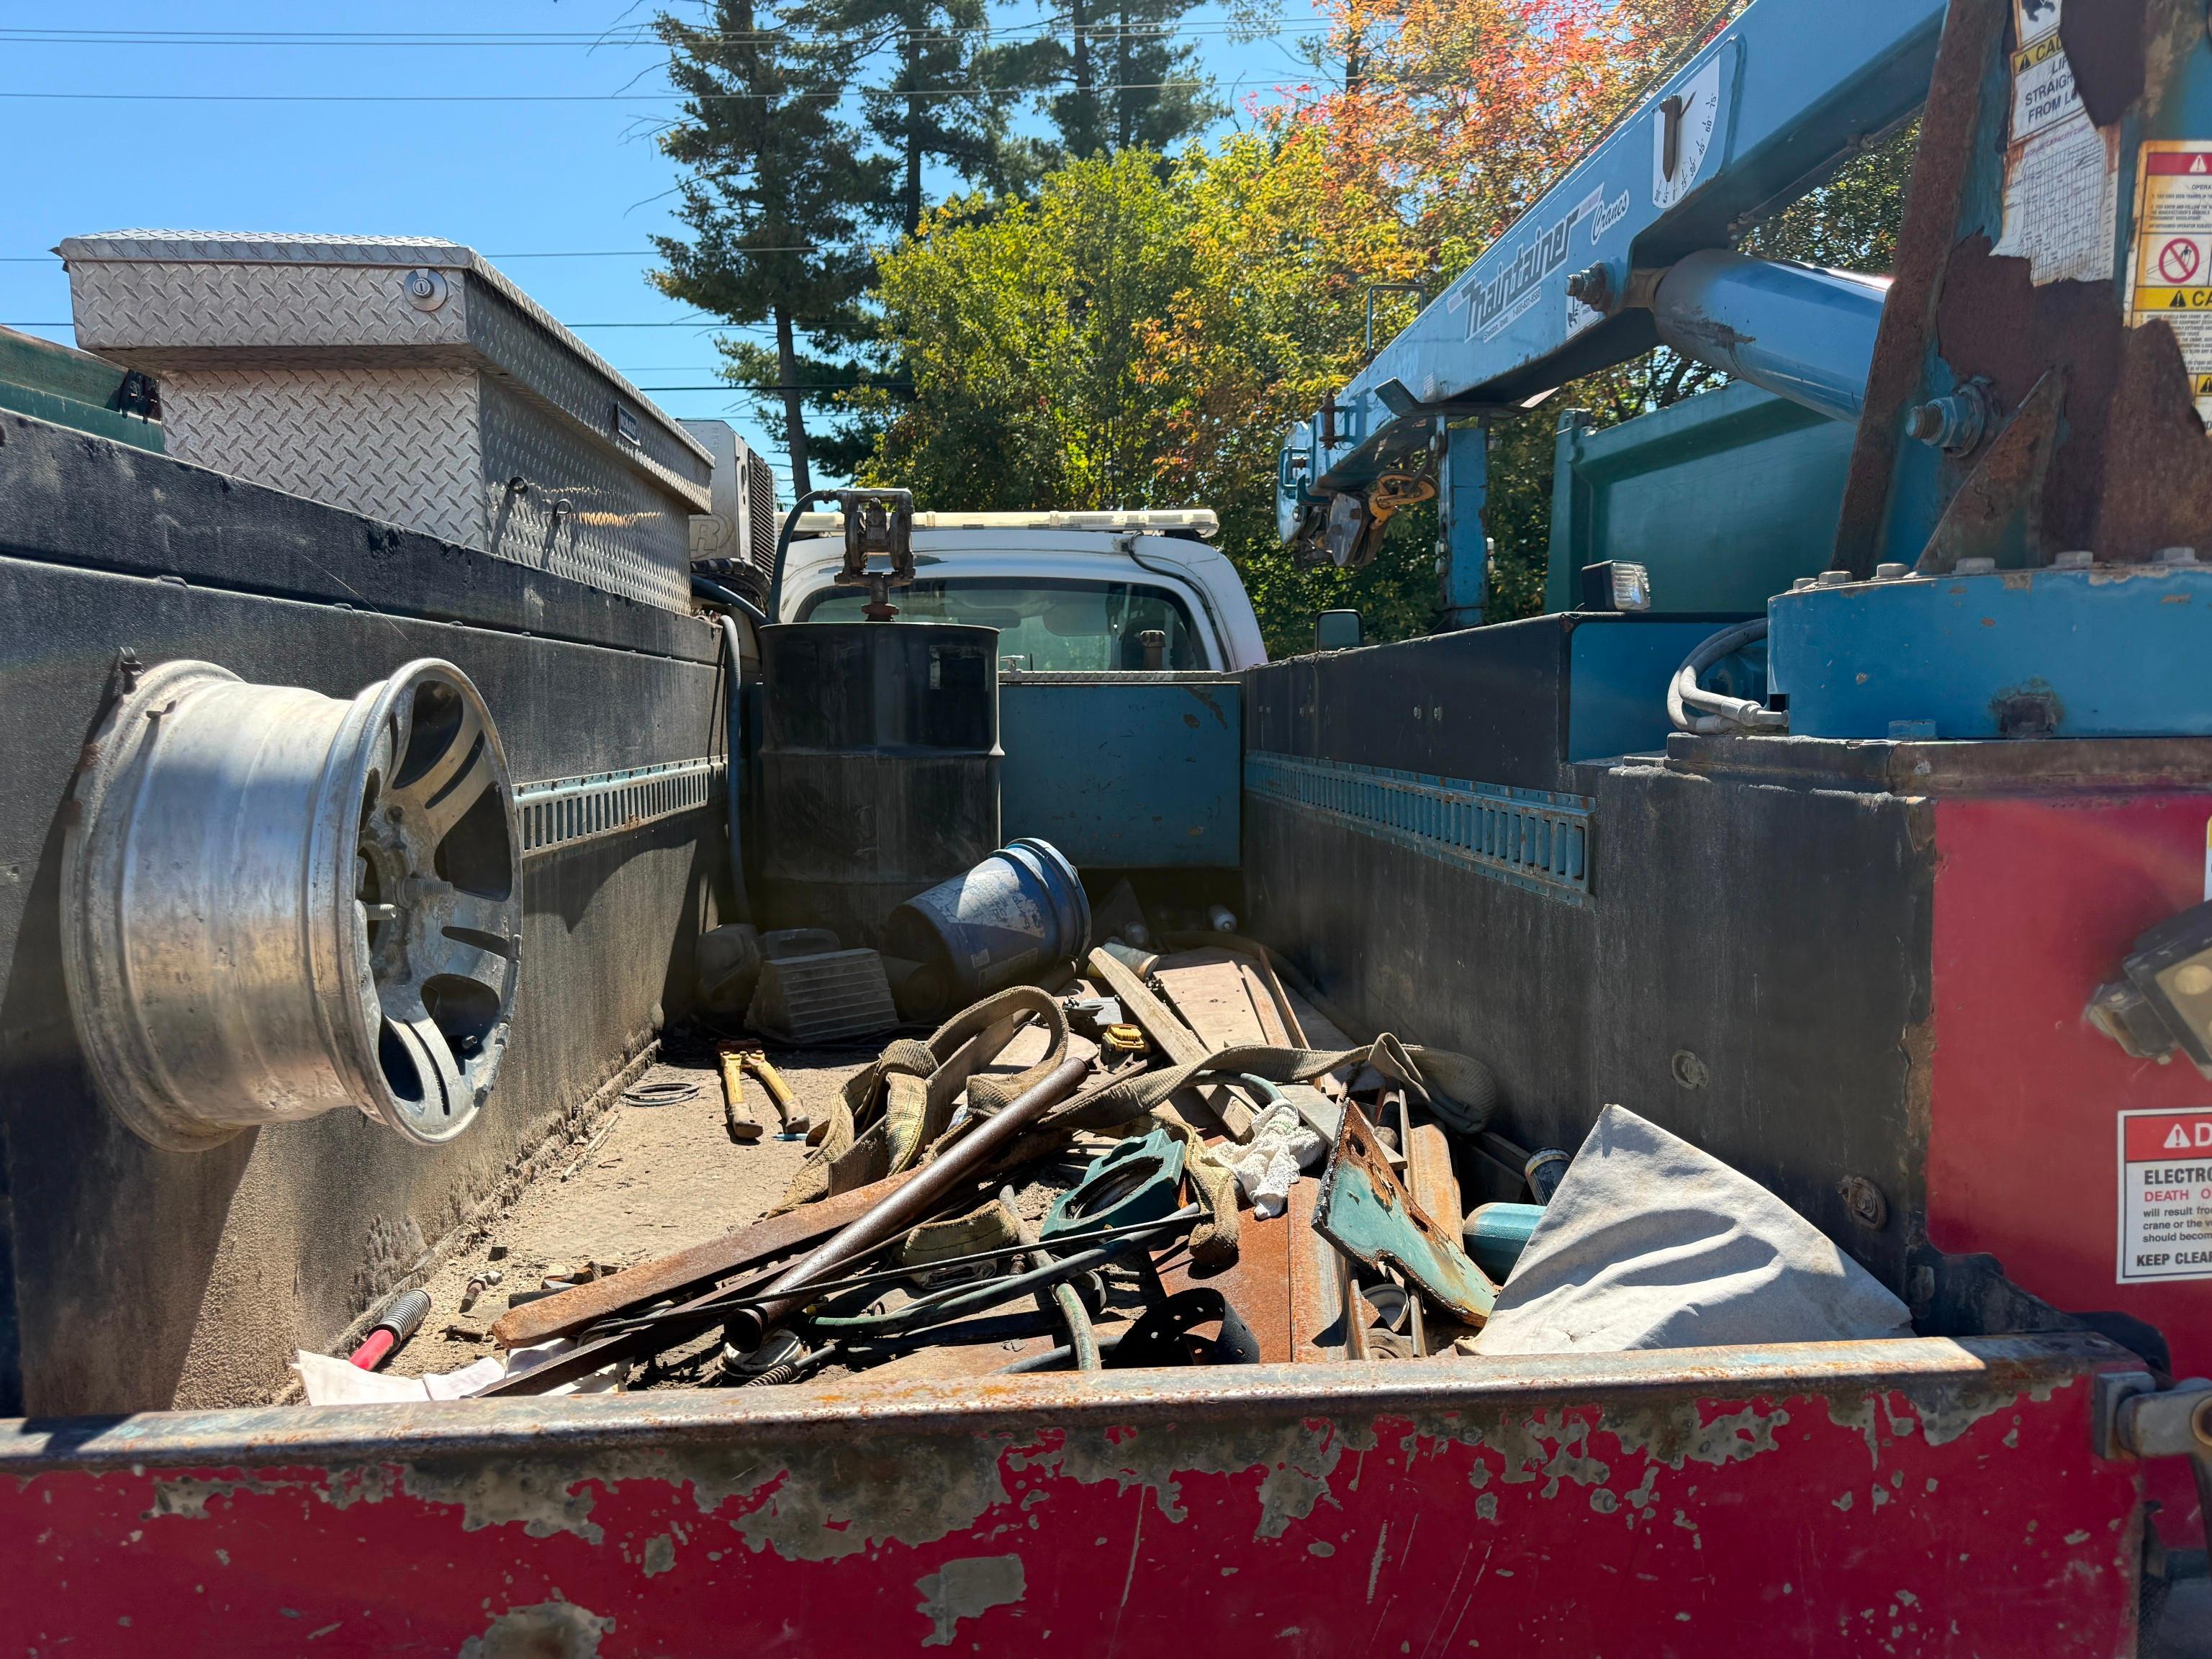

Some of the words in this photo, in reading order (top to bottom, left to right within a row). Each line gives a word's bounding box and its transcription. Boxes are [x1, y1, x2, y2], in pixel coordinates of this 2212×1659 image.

[2028, 96, 2061, 123] FROM
[1592, 191, 1628, 243] Cranes
[2144, 1189, 2189, 1203] DEATH
[2200, 1188, 2212, 1200] O
[2143, 1208, 2160, 1218] will
[2164, 1207, 2193, 1217] result
[2142, 1222, 2171, 1231] crane
[2173, 1221, 2184, 1229] or
[2186, 1219, 2202, 1228] the
[2142, 1232, 2177, 1243] should
[2136, 1253, 2170, 1267] KEEP
